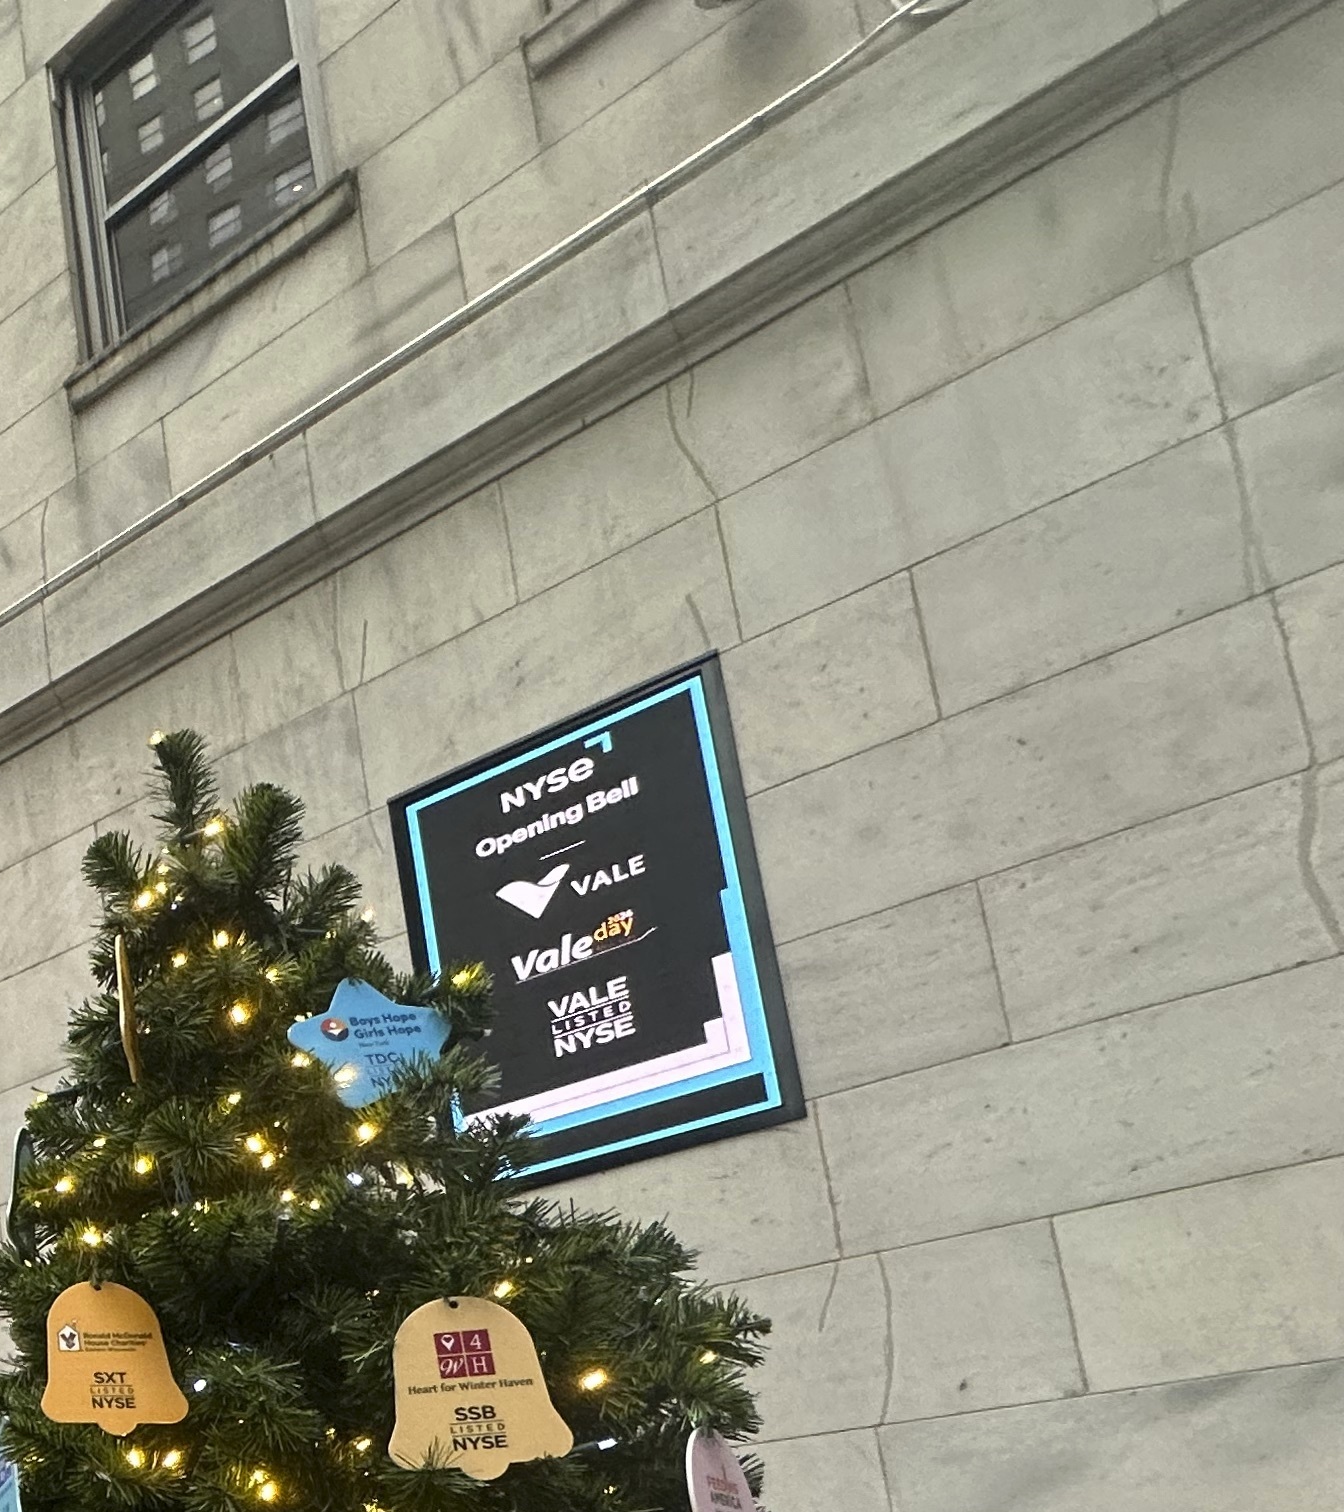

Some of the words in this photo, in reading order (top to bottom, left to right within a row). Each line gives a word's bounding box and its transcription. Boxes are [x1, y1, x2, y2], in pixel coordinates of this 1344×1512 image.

[475, 802, 584, 858] Opening
[586, 777, 640, 816] Bell
[570, 854, 646, 897] VALE
[547, 976, 629, 1019] VALE
[349, 1016, 380, 1028] Boys
[382, 1013, 416, 1023] Hope
[551, 999, 631, 1035] LISTED
[354, 1028, 384, 1039] Girls
[388, 1025, 422, 1036] Hope
[553, 1016, 637, 1059] NYSE
[364, 1052, 400, 1065] TDC
[470, 1334, 482, 1350] 4
[473, 1356, 489, 1373] H
[94, 1372, 126, 1384] SXT
[408, 1385, 438, 1395] Heart
[440, 1382, 457, 1392] for
[458, 1380, 496, 1391] Winter
[499, 1377, 534, 1388] Haven
[90, 1387, 135, 1395] LISTED
[92, 1397, 136, 1409] NYSE
[454, 1405, 496, 1421] SSB
[450, 1424, 506, 1434] LISTED
[452, 1435, 508, 1451] NYSE
